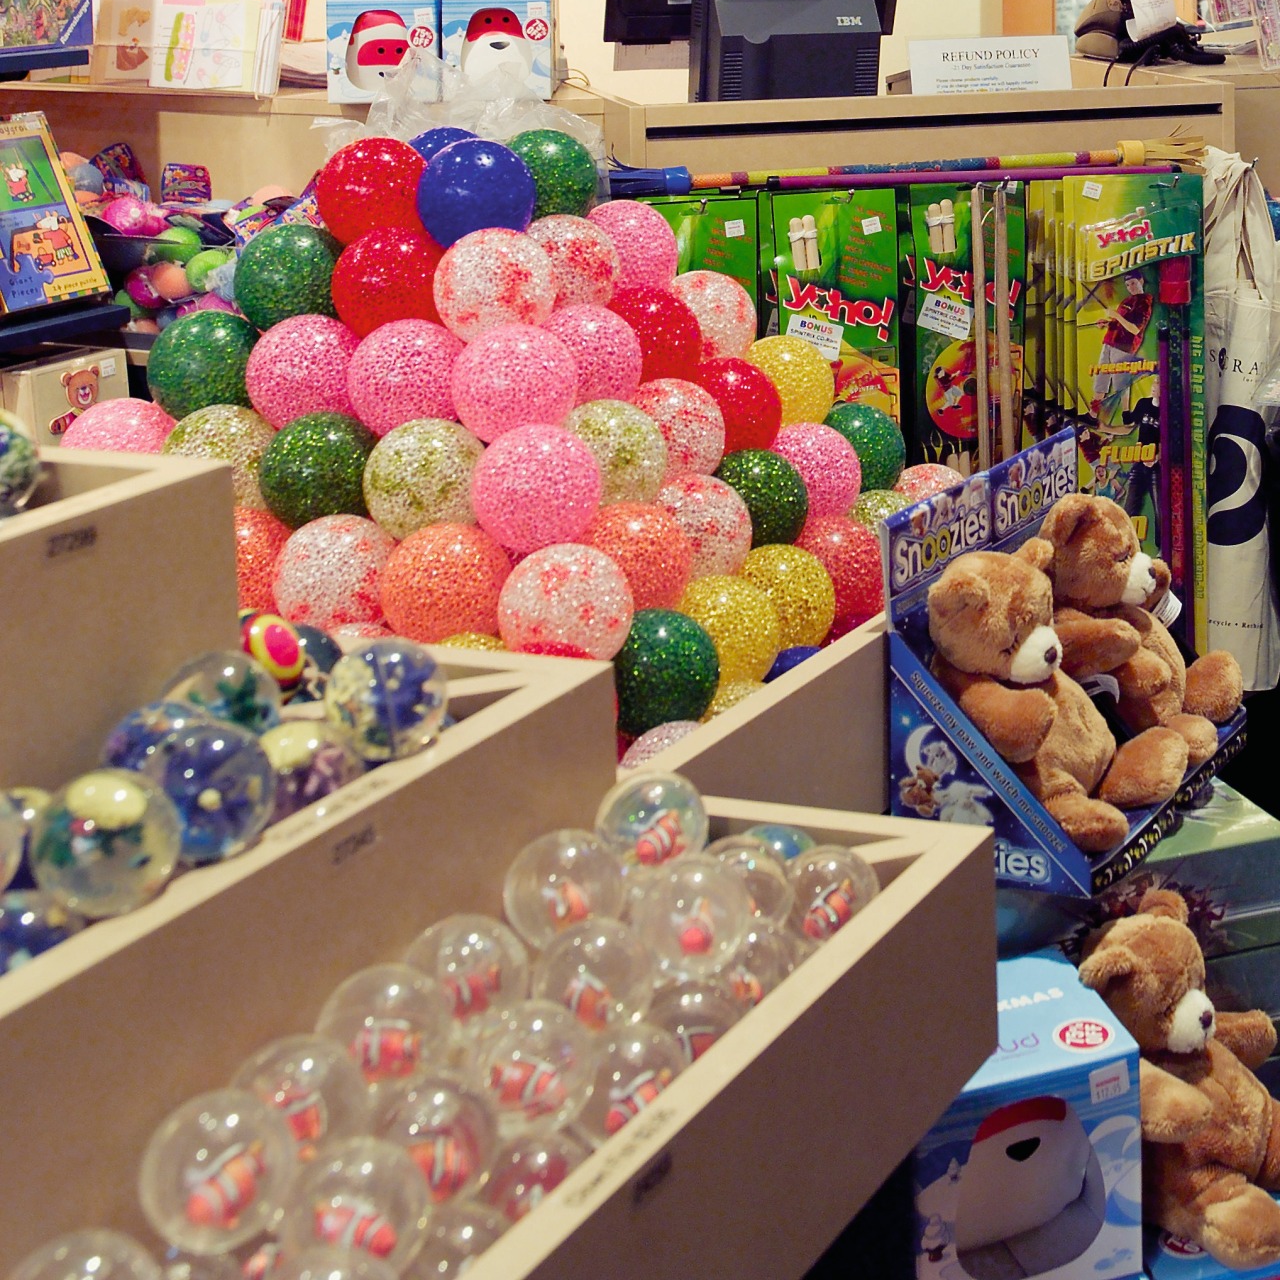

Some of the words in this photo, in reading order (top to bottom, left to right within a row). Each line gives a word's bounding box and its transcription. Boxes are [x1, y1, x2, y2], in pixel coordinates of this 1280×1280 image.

[60, 0, 90, 44] Ravensburger
[414, 26, 434, 39] 75%
[836, 16, 863, 26] IBM
[412, 36, 431, 47] OFF
[942, 51, 993, 62] REFUND
[996, 48, 1040, 60] POLICY
[935, 299, 965, 315] BONUS
[800, 320, 833, 335] BONUS
[1210, 348, 1261, 375] SOCRA
[1191, 363, 1205, 394] the
[1191, 401, 1205, 442] flow
[1191, 450, 1205, 490] zone
[996, 465, 1076, 532] Snoozies
[895, 509, 989, 583] Snoozies
[910, 672, 945, 711] Squeeze
[943, 707, 959, 732] my
[956, 726, 978, 753] paw
[975, 745, 995, 771] and
[992, 764, 1020, 800] watch
[1017, 794, 1034, 816] me
